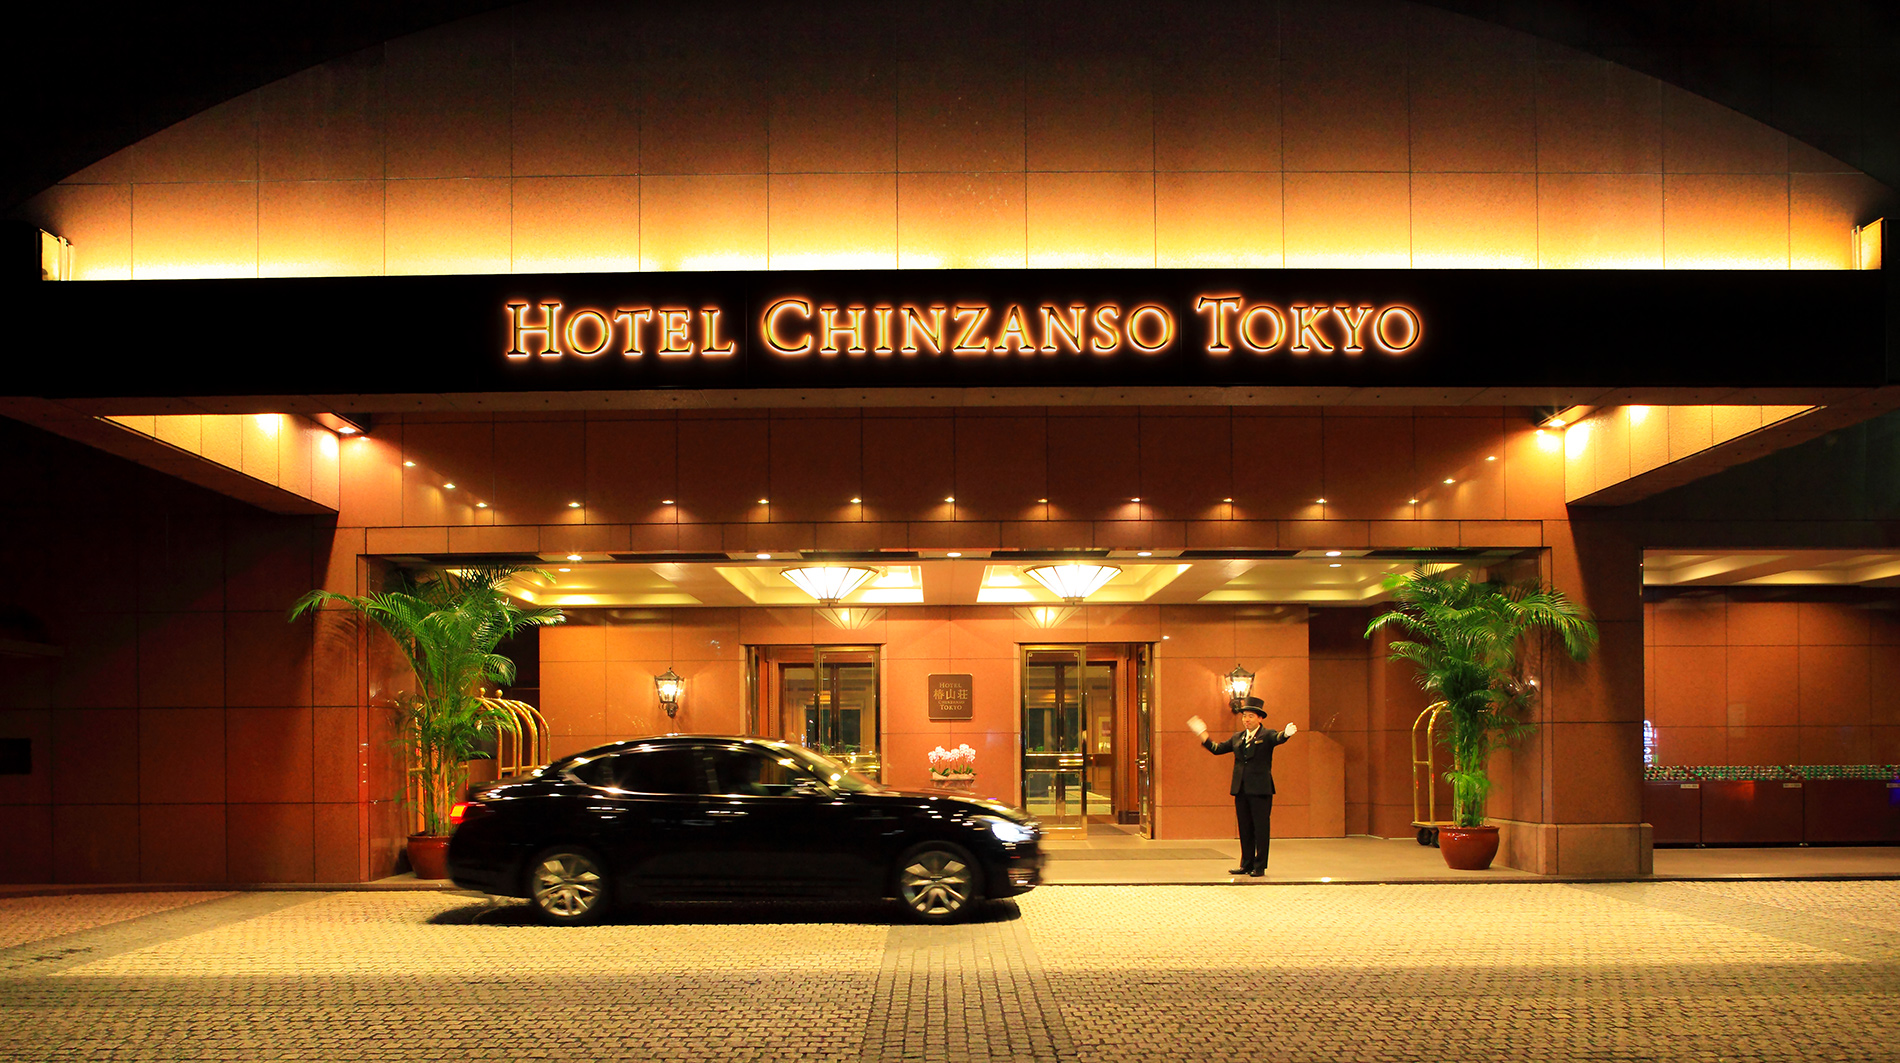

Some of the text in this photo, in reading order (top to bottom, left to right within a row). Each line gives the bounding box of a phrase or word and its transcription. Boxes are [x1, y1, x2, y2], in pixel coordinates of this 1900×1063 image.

[506, 295, 1422, 357] HOTEL CHINZANSO TOKYO
[933, 689, 968, 700] 椿山荘
